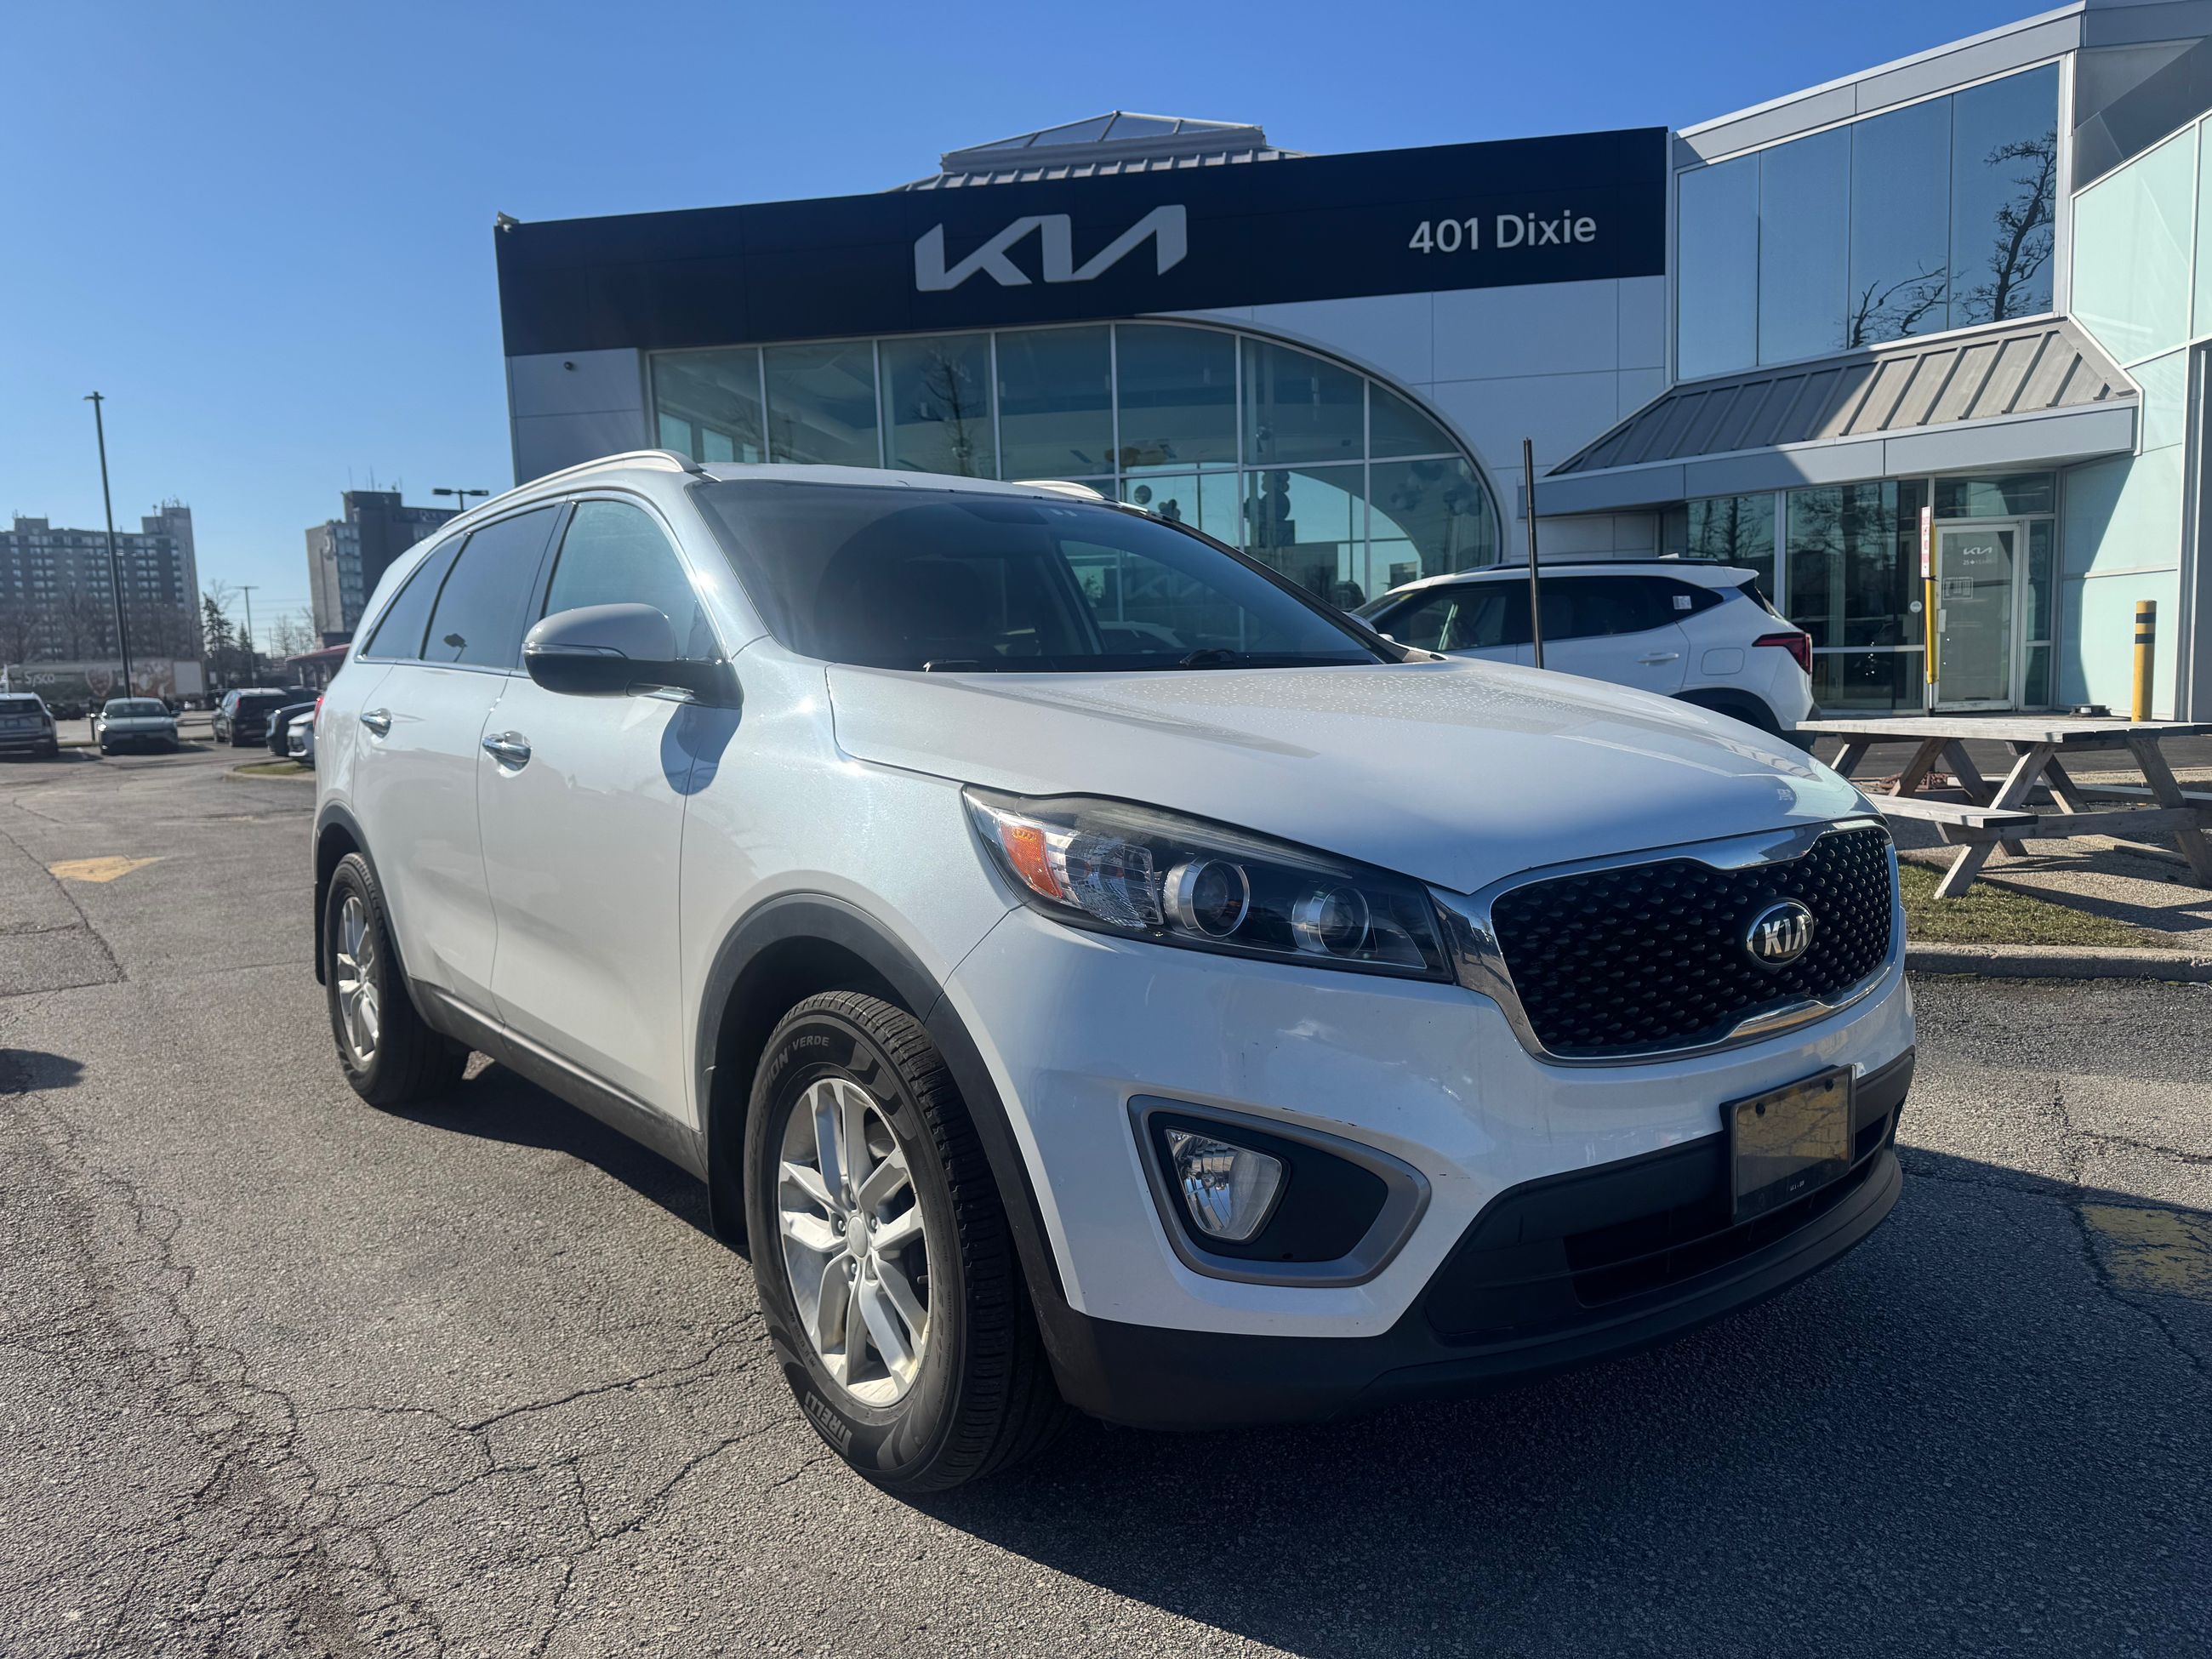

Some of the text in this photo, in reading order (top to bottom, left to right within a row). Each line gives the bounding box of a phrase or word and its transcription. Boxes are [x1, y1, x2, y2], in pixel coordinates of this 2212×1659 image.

[914, 204, 1188, 292] KIA
[1408, 209, 1597, 254] 401 Dixie
[1963, 546, 1993, 556] KIA
[1763, 915, 1809, 957] KIA
[749, 1035, 830, 1172] SCORPION VERDE
[803, 1390, 853, 1457] PIRELLI
